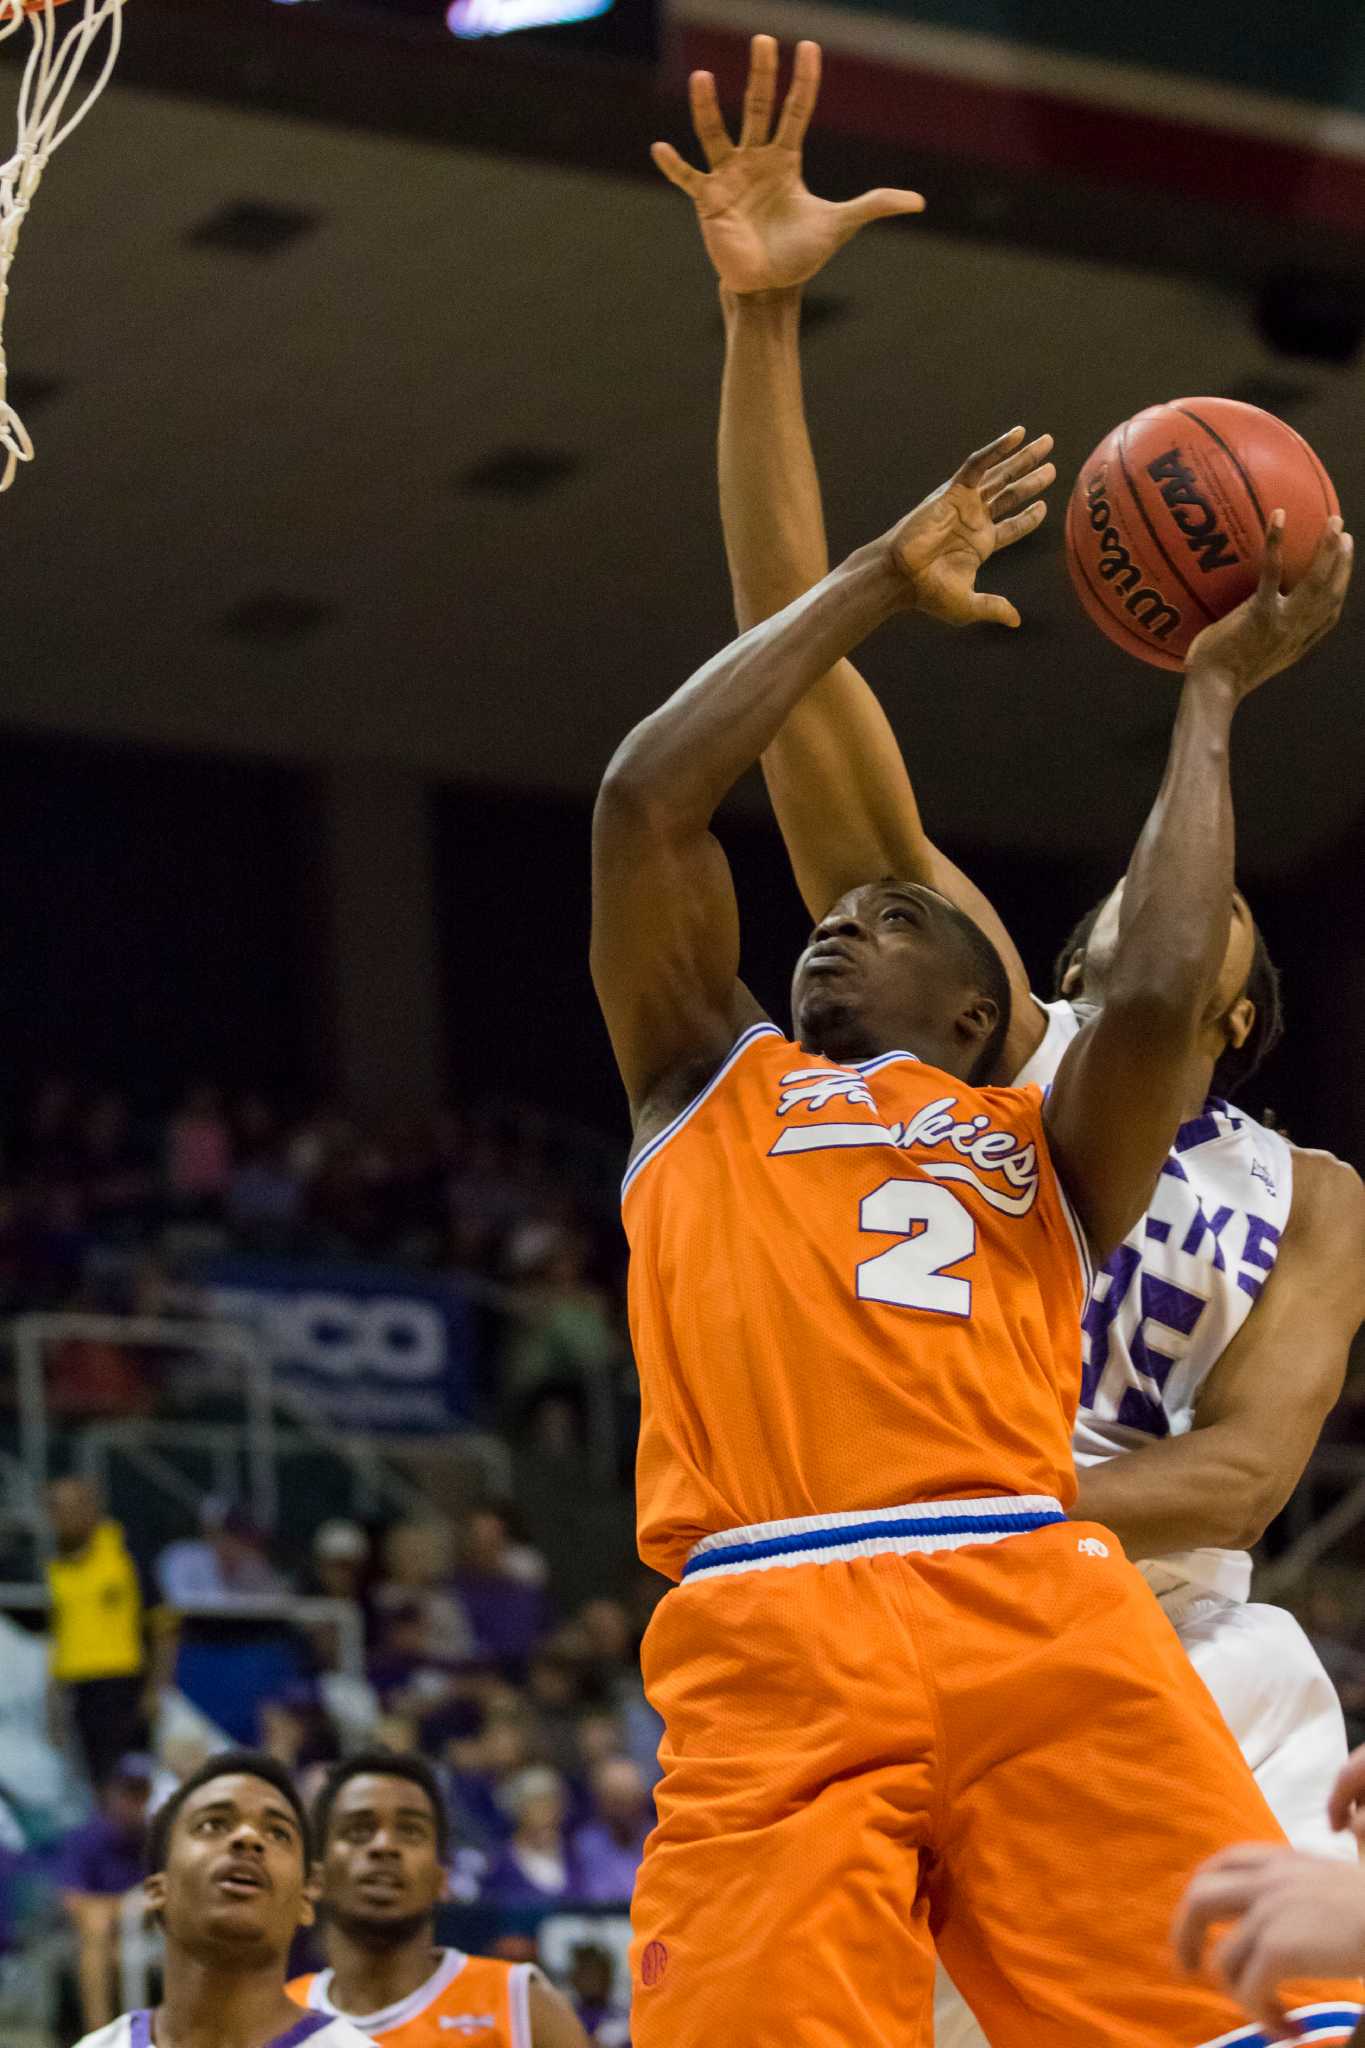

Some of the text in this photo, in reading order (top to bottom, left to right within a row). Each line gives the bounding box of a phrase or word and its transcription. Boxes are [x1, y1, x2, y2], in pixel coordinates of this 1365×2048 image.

[1087, 473, 1183, 642] Wilson
[1147, 447, 1241, 574] NCAA
[774, 1068, 1040, 1188] Hkies
[855, 1177, 977, 1320] 2
